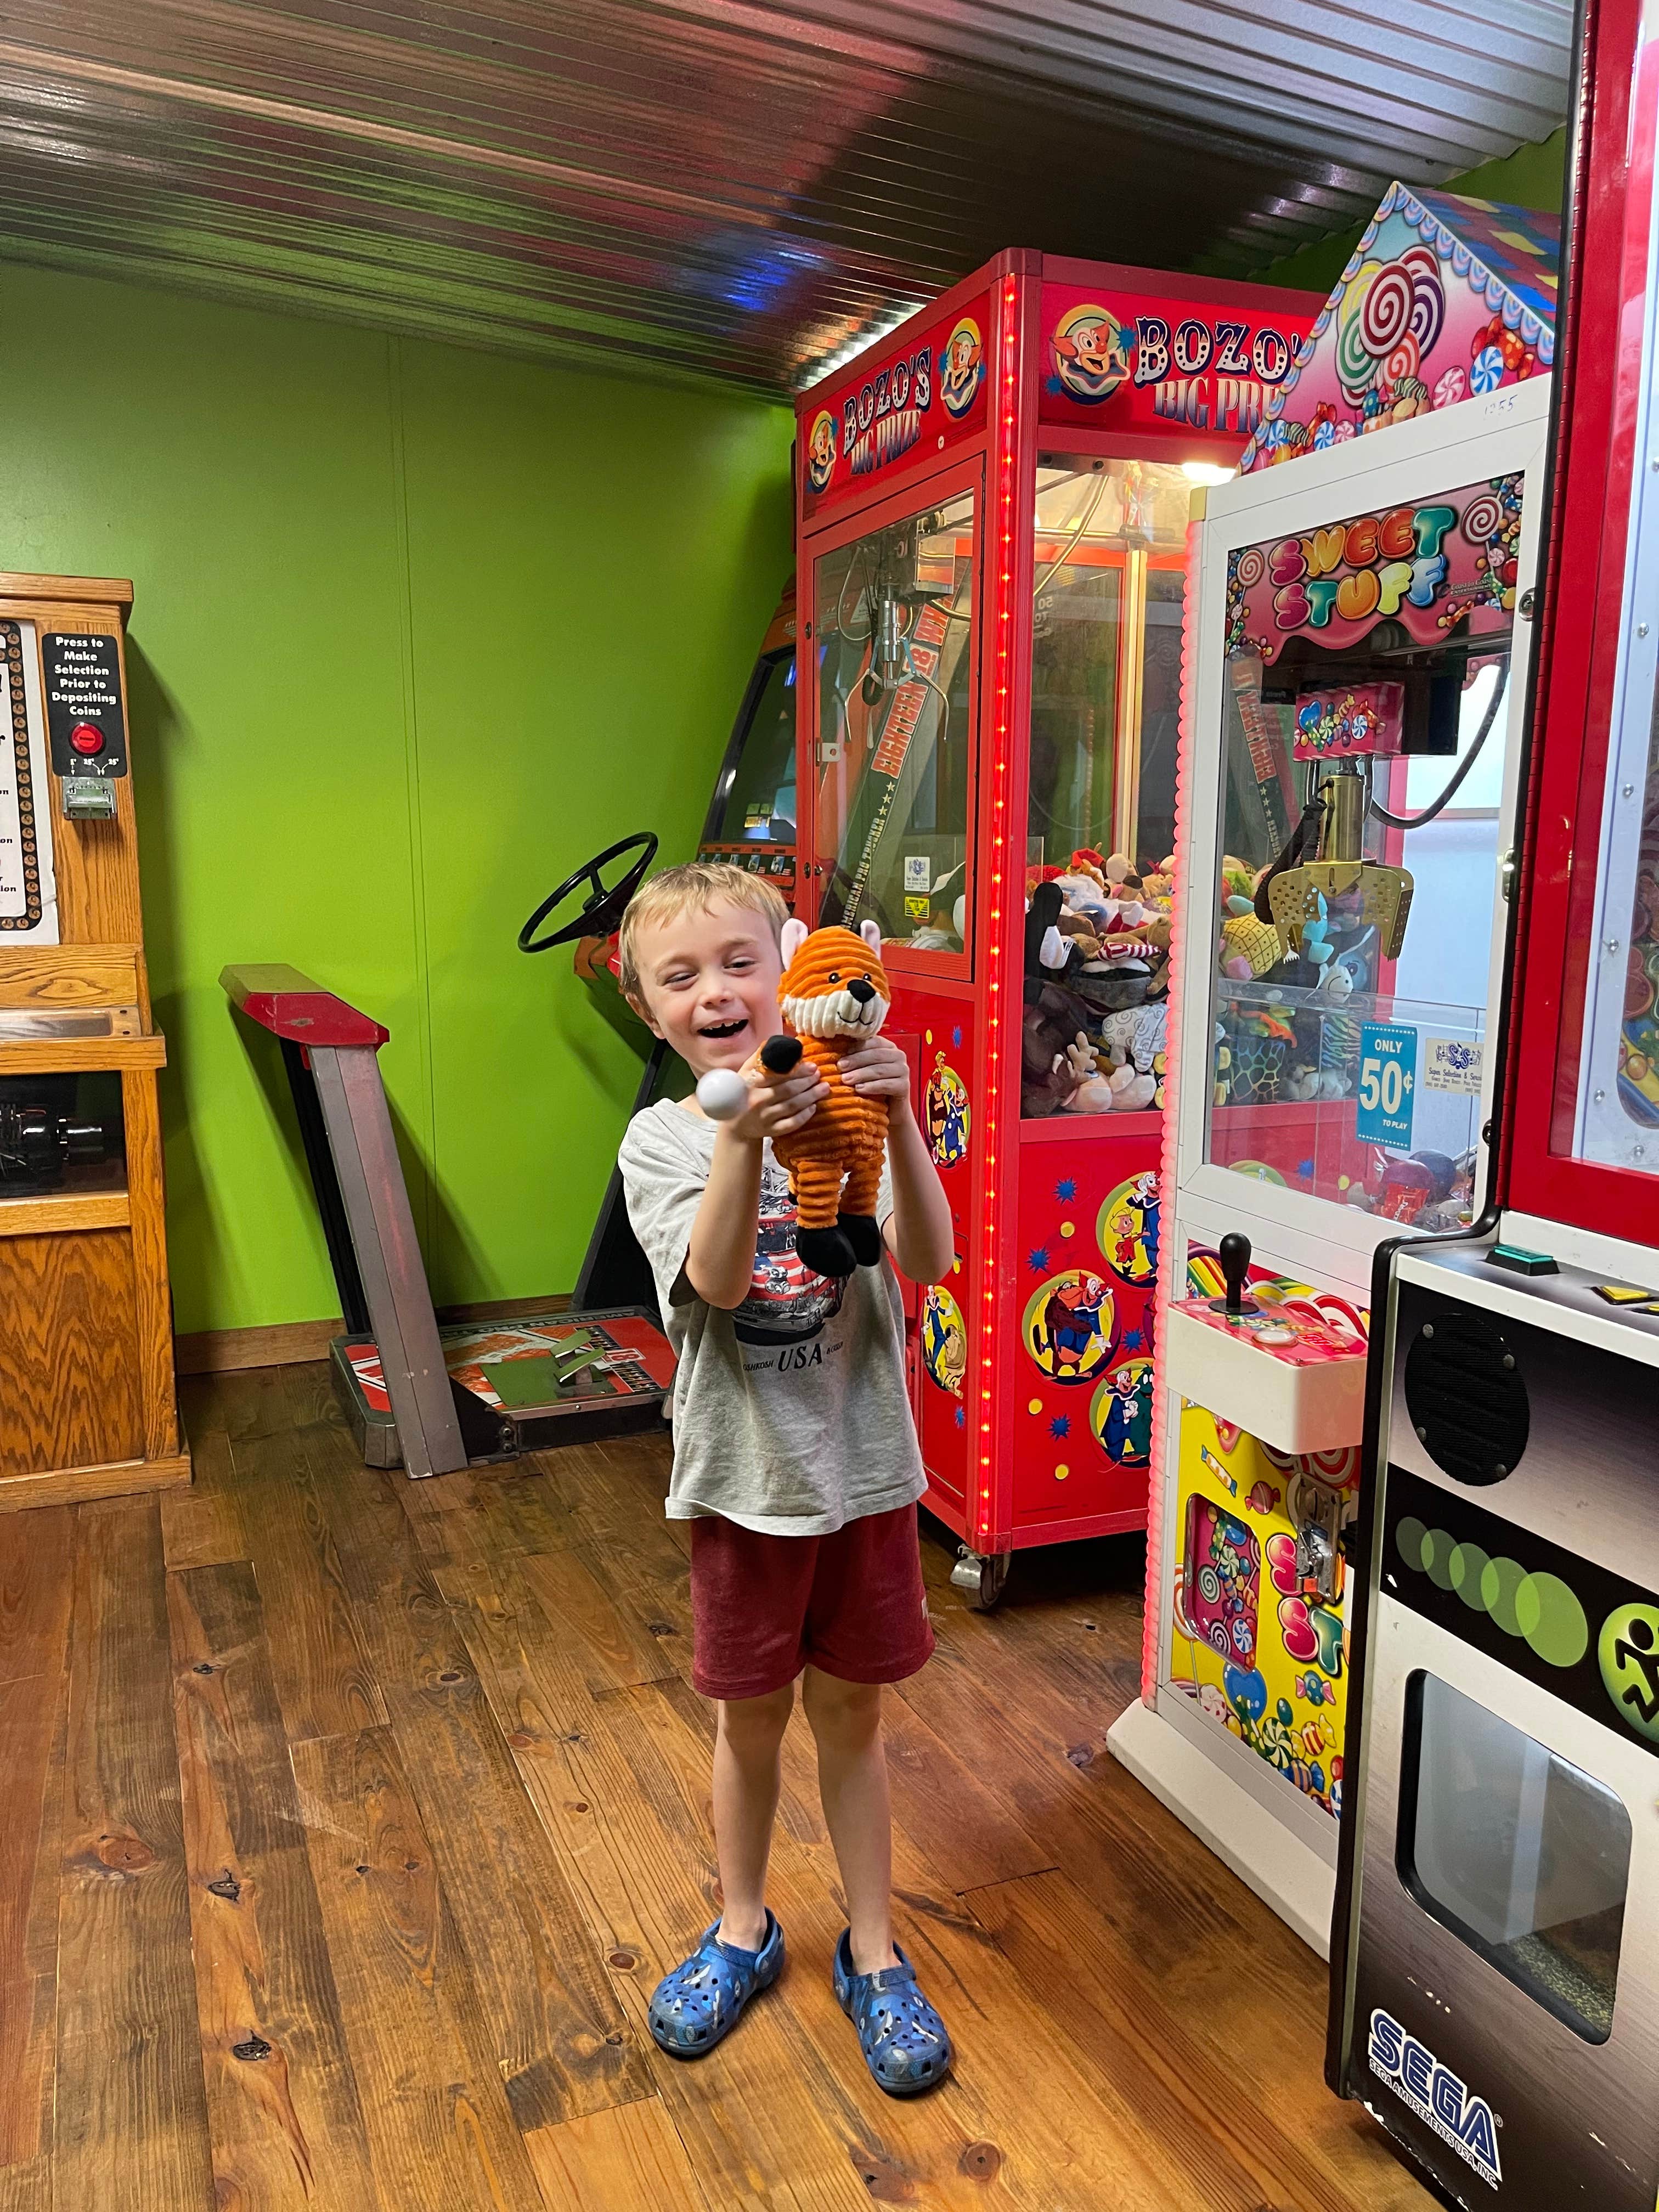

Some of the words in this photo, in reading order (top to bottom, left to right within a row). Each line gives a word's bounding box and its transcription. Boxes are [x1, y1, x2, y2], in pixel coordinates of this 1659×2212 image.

[1133, 315, 1302, 388] BOZO'
[843, 346, 932, 459] BOZO'S
[1153, 376, 1209, 431] BIG
[1213, 377, 1281, 434] PRI
[851, 429, 874, 475] BIG
[876, 410, 922, 470] PRIZE
[1269, 507, 1455, 586] SWEET
[1274, 553, 1447, 630] STUFF
[54, 664, 109, 675] Selection
[55, 636, 88, 647] Press
[91, 638, 104, 647] to
[64, 651, 98, 661] Make
[52, 691, 116, 705] Depositing
[60, 678, 91, 689] Prior
[94, 680, 106, 689] to
[69, 706, 101, 716] Coins
[871, 681, 929, 780] EIGHTEEN
[1375, 1039, 1402, 1053] ONLY
[1359, 1057, 1414, 1114] 50¢
[1383, 1119, 1391, 1127] TO
[1391, 1121, 1408, 1130] PLAY
[778, 1343, 822, 1372] USA
[1369, 2008, 1502, 2182] SEGA
[1369, 2058, 1393, 2090] SEGA
[1392, 2080, 1454, 2148] AMUSEMENTS
[1454, 2140, 1479, 2172] USA,
[1477, 2160, 1499, 2191] INC.
